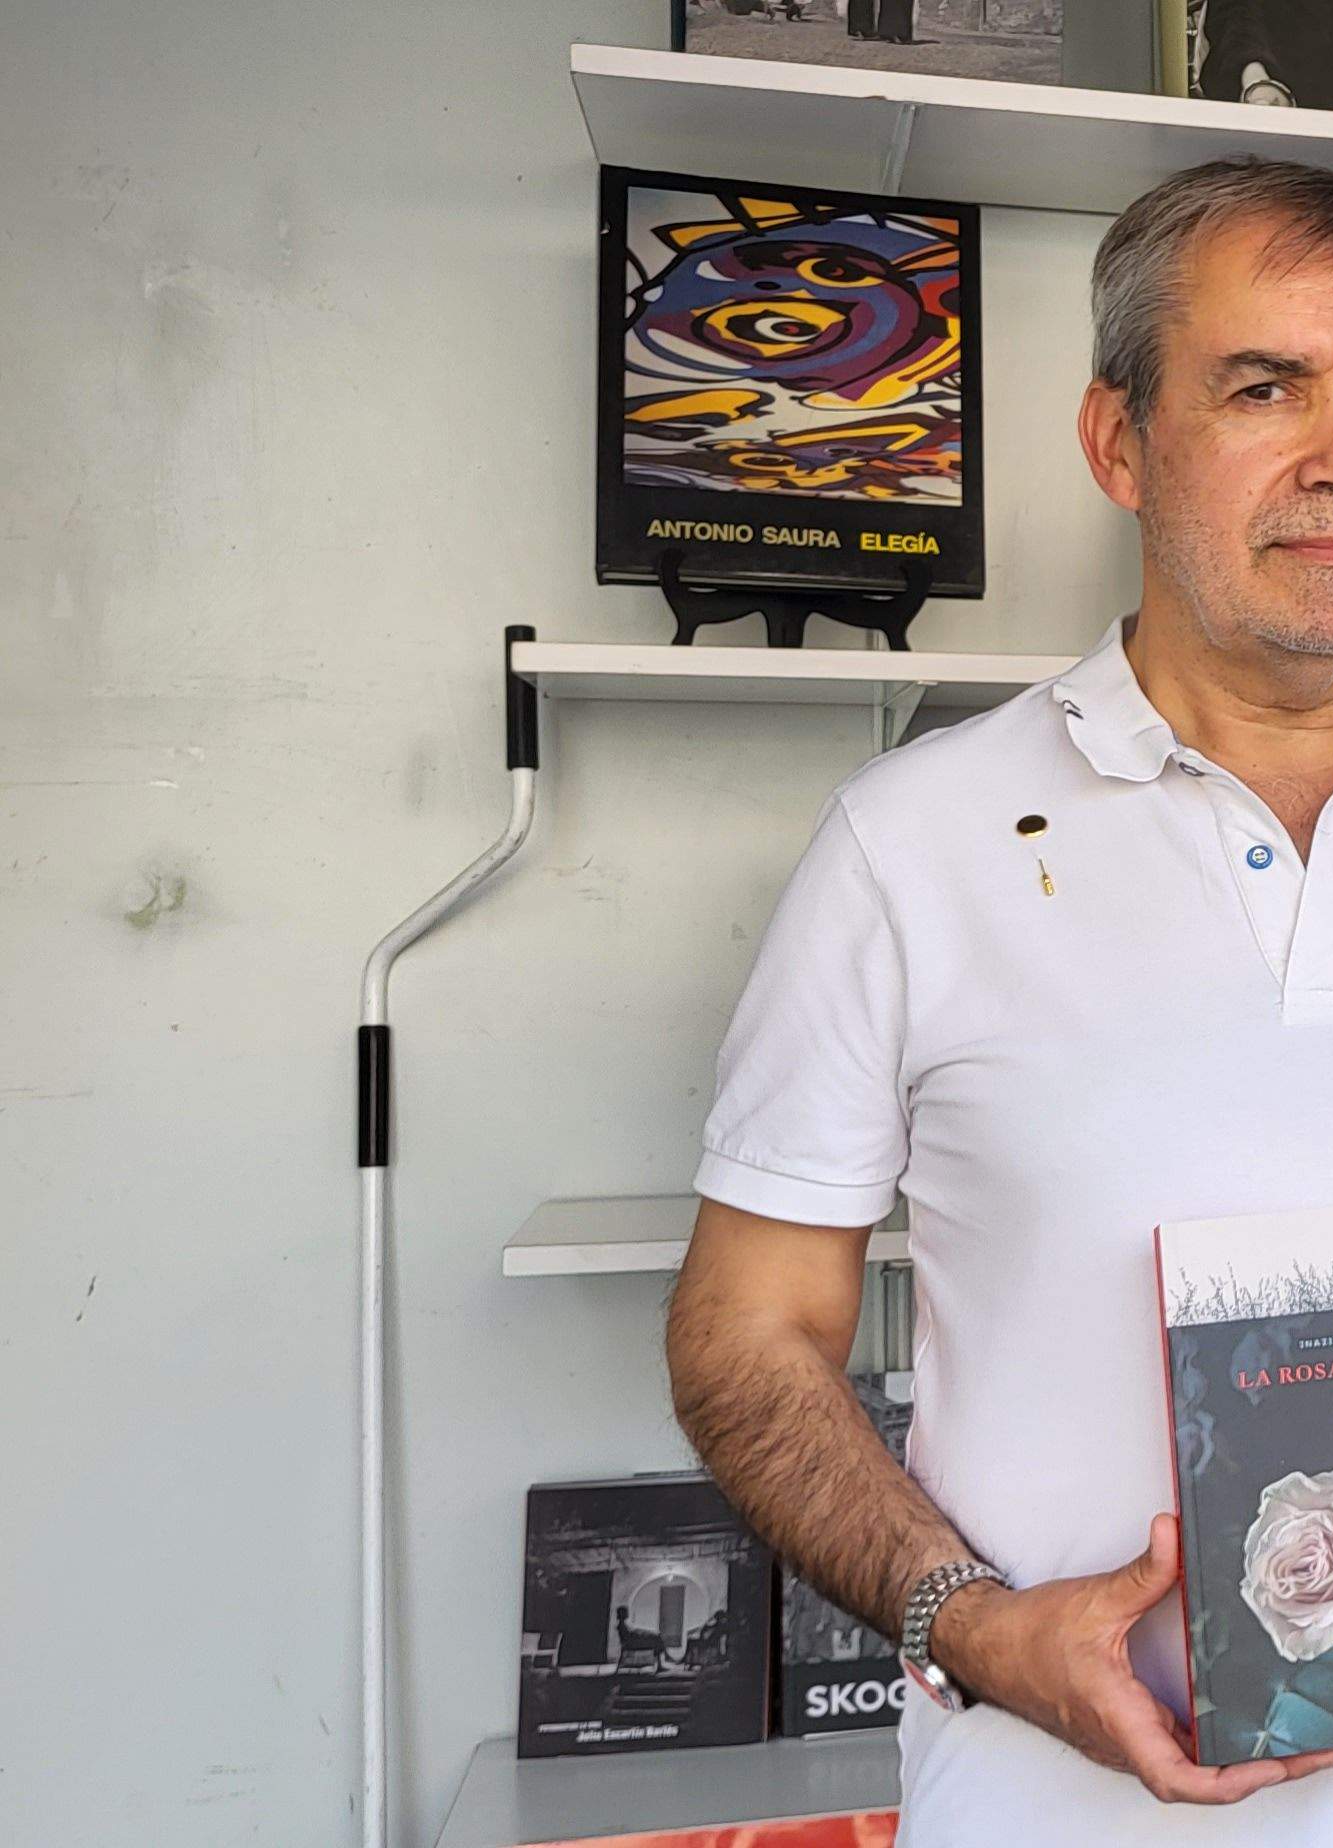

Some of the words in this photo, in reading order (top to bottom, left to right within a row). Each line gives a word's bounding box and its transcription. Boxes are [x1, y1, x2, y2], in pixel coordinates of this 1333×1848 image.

[646, 518, 754, 543] ANTONIO
[761, 525, 842, 549] SAURA
[860, 531, 941, 556] ELEGÍA
[1238, 1368, 1272, 1389] LA
